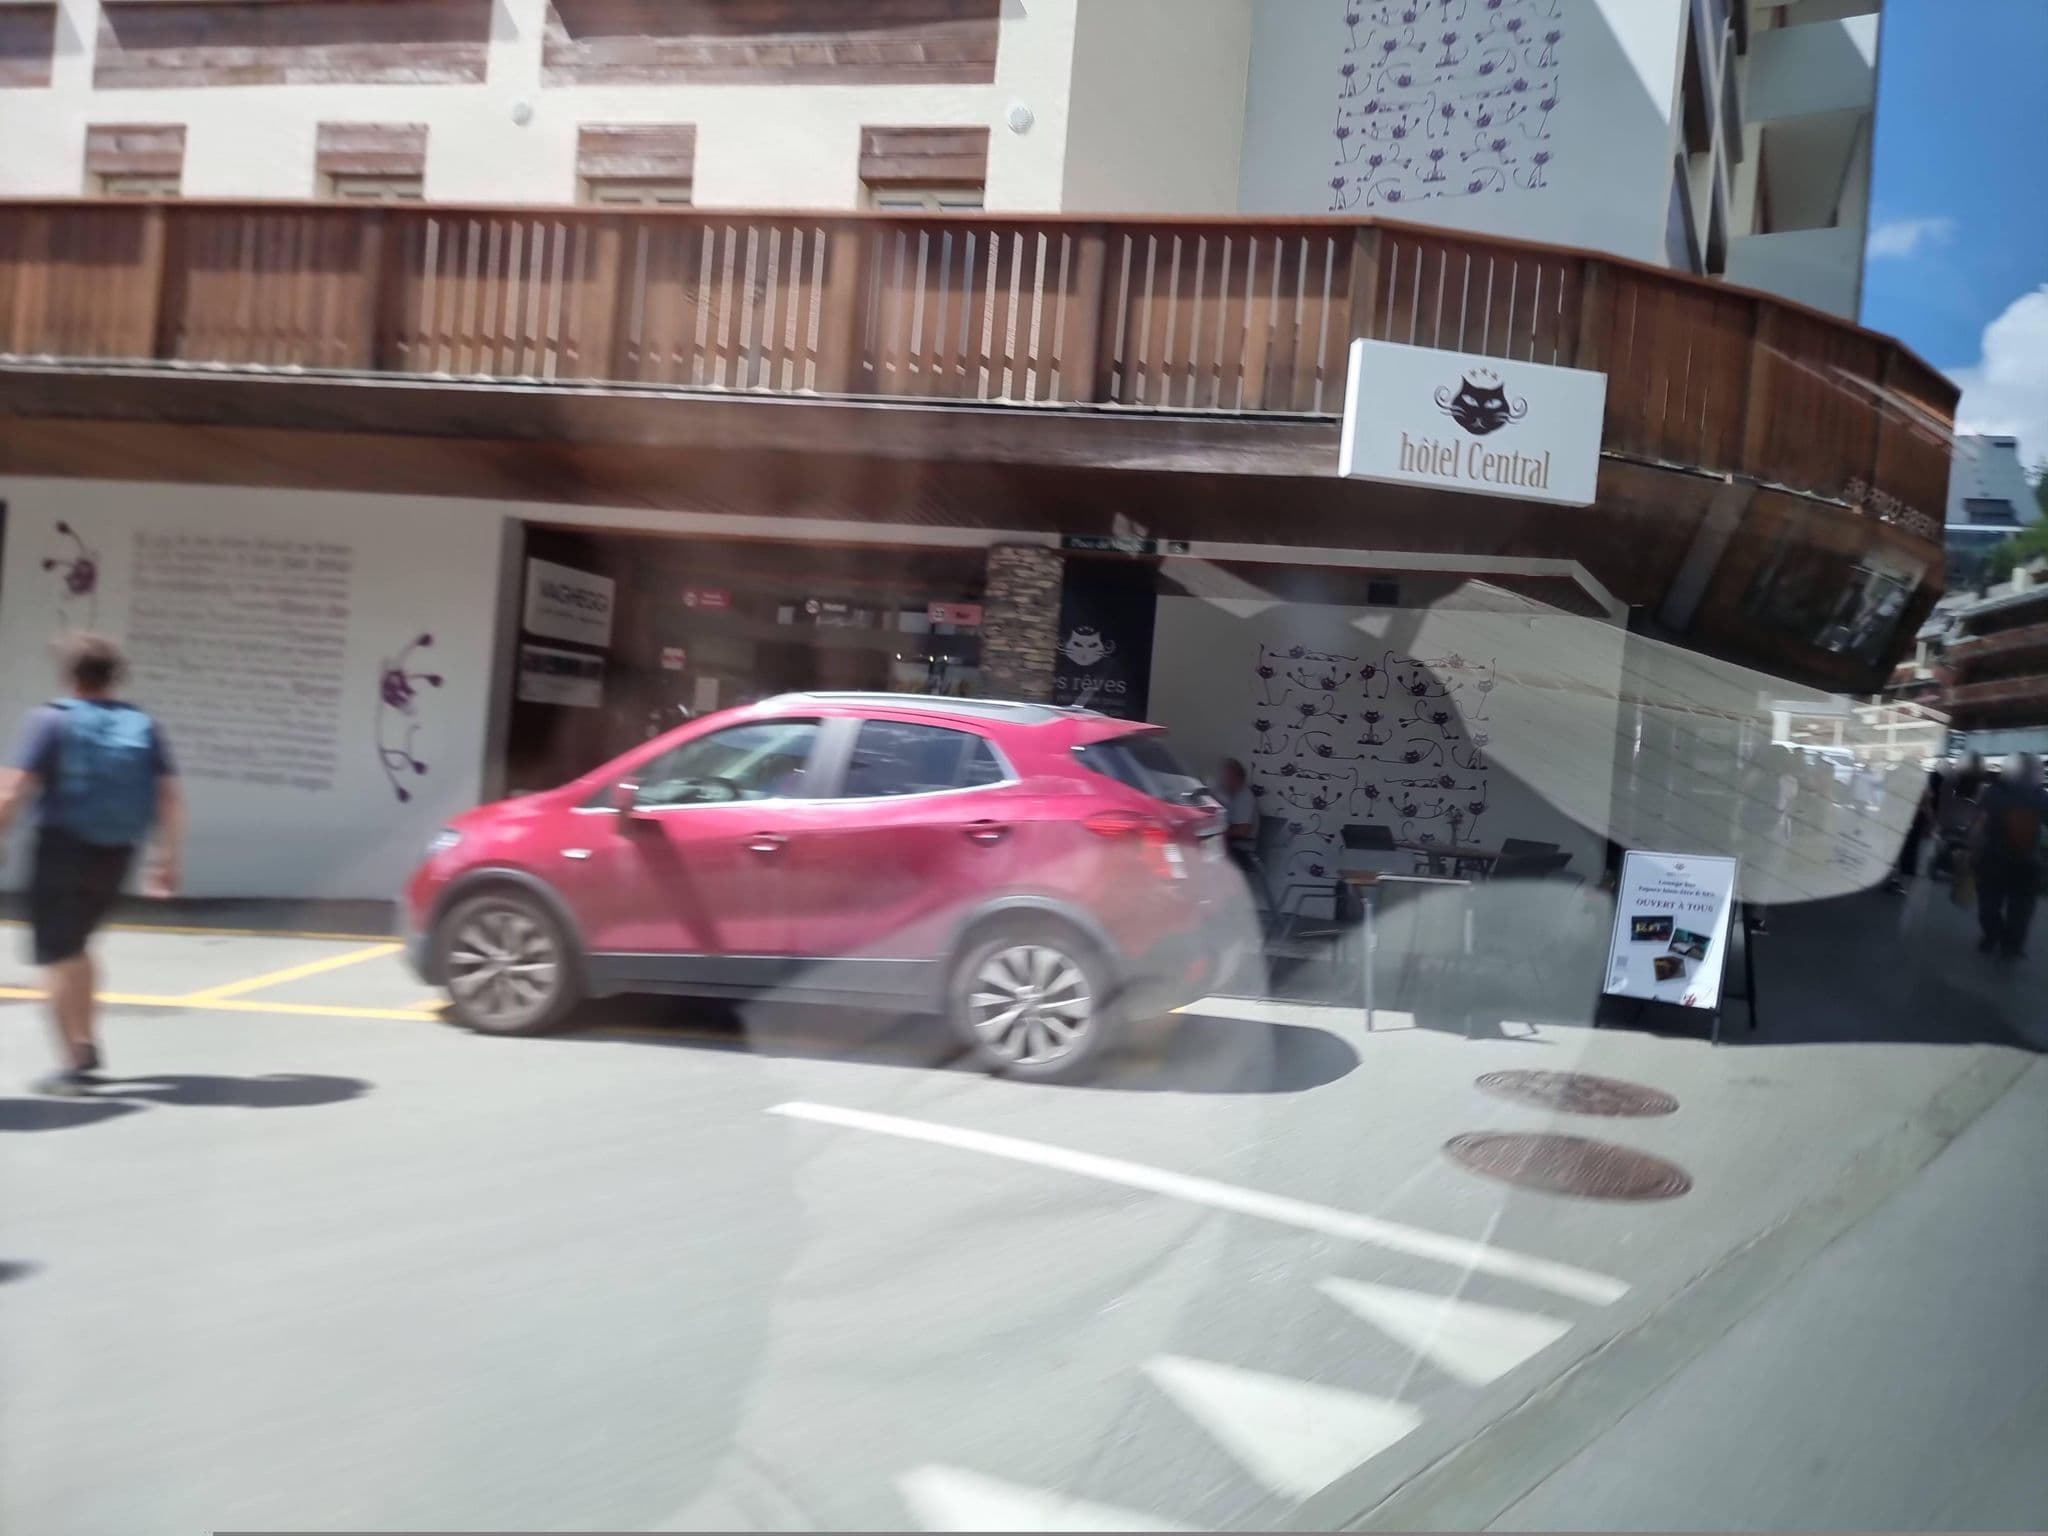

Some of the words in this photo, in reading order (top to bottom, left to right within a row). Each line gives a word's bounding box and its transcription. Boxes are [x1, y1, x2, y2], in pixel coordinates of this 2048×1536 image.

[1399, 431, 1460, 479] hôtel
[1467, 441, 1551, 489] Central
[1073, 673, 1127, 694] rêves
[1636, 898, 1676, 909] OUVERT
[1687, 903, 1714, 913] TOUS
